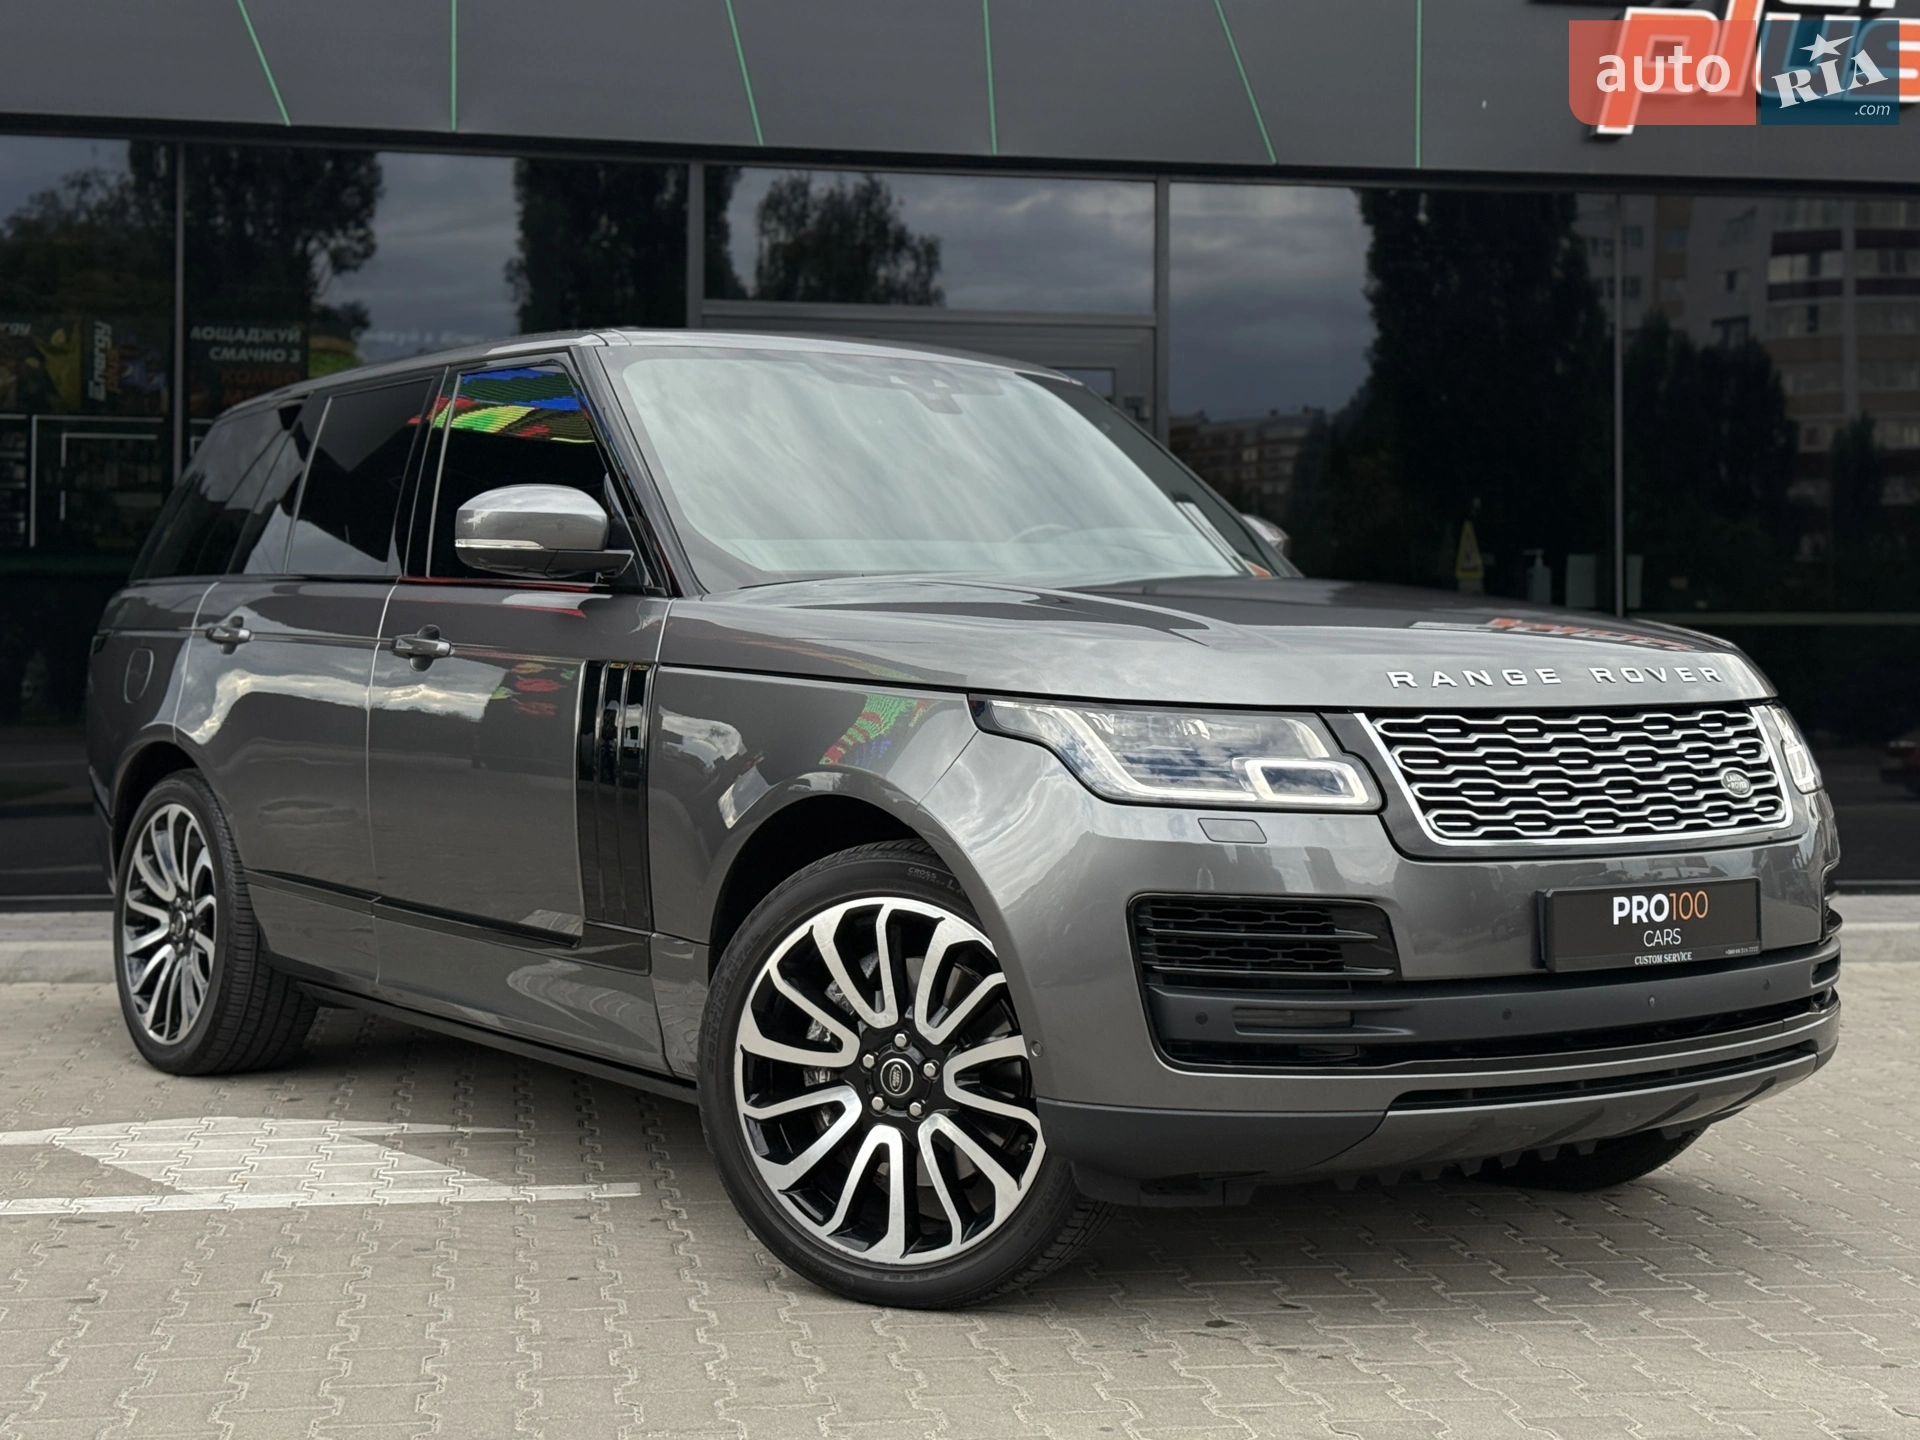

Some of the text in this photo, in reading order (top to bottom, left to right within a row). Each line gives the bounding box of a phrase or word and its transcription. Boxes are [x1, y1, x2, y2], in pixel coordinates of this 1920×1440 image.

[88, 320, 113, 402] Energy
[208, 345, 288, 363] СМАЧНО
[1387, 666, 1723, 689] RANGE ROVER
[908, 866, 937, 880] CROSS
[1613, 890, 1709, 926] PRO100
[1643, 927, 1682, 948] CARS
[1634, 951, 1693, 966] CUSTOM SERVICE
